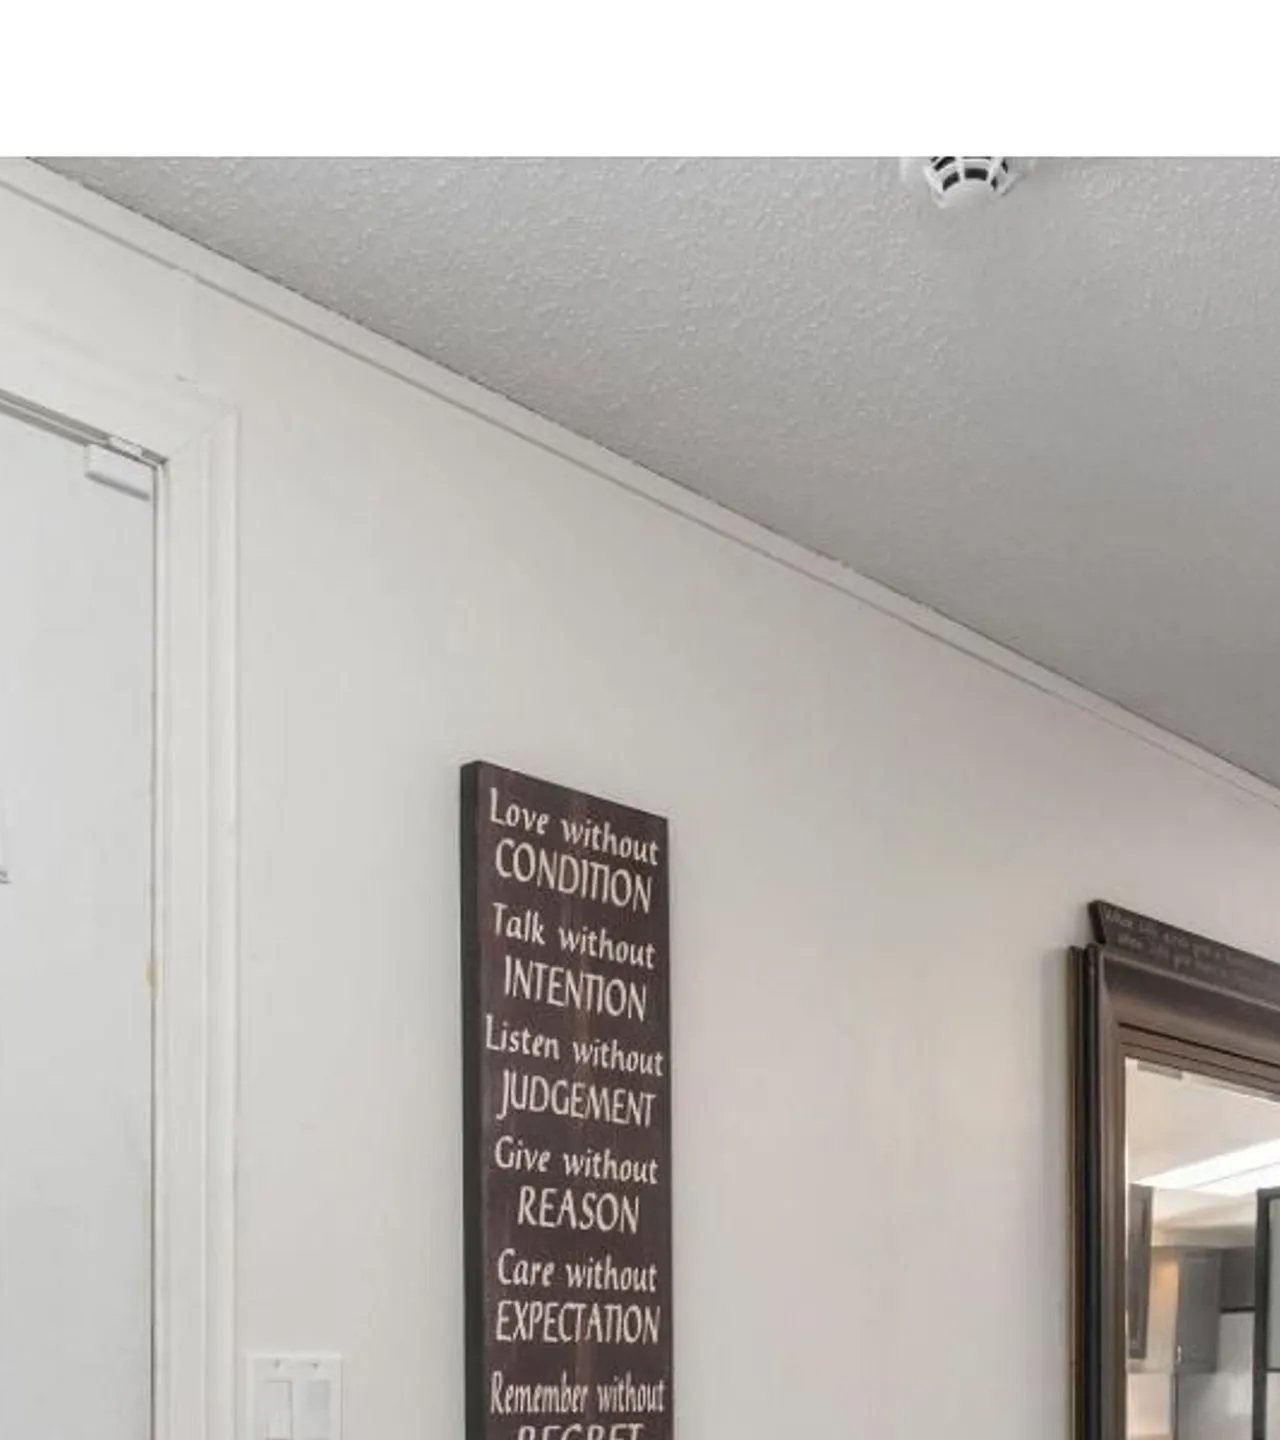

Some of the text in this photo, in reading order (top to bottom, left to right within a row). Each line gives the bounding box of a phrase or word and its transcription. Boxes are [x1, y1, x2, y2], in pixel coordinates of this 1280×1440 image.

[489, 787, 659, 866] Love without
[495, 838, 652, 914] CONDITION
[492, 902, 656, 970] Talk without
[504, 955, 646, 1022] INTENTION
[485, 1013, 664, 1077] Listen without
[496, 1069, 656, 1129] JUDGEMENT
[495, 1136, 659, 1185] Give without
[517, 1185, 640, 1235] REASON
[497, 1248, 658, 1293] Care without
[495, 1300, 662, 1346] EXPECTATION
[490, 1370, 665, 1414] Remember without
